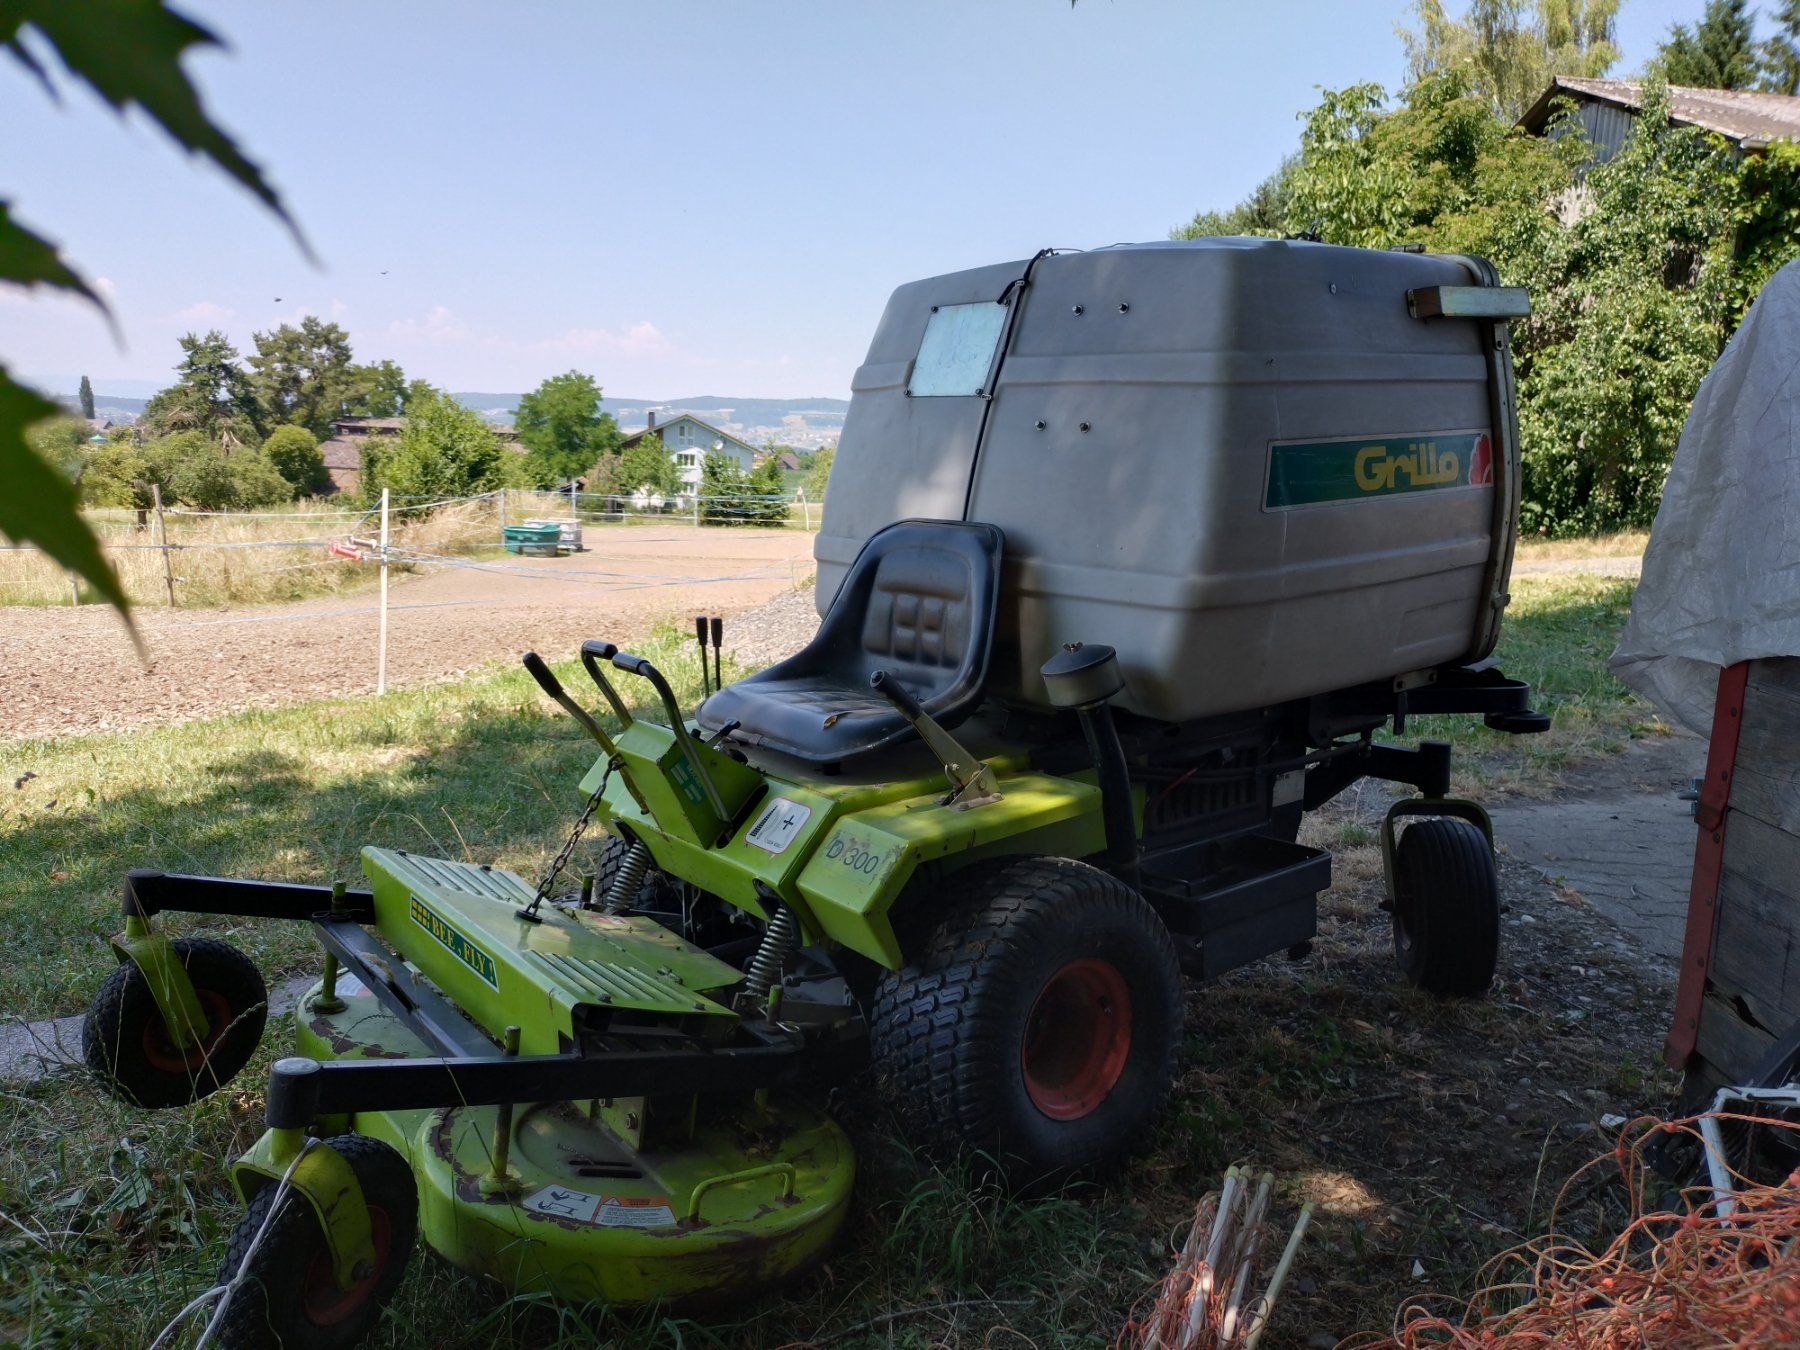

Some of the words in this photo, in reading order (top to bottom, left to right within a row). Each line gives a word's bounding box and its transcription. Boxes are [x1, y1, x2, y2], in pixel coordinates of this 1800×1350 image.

[1354, 443, 1459, 491] Grillo
[826, 839, 845, 859] D
[844, 848, 879, 875] 300
